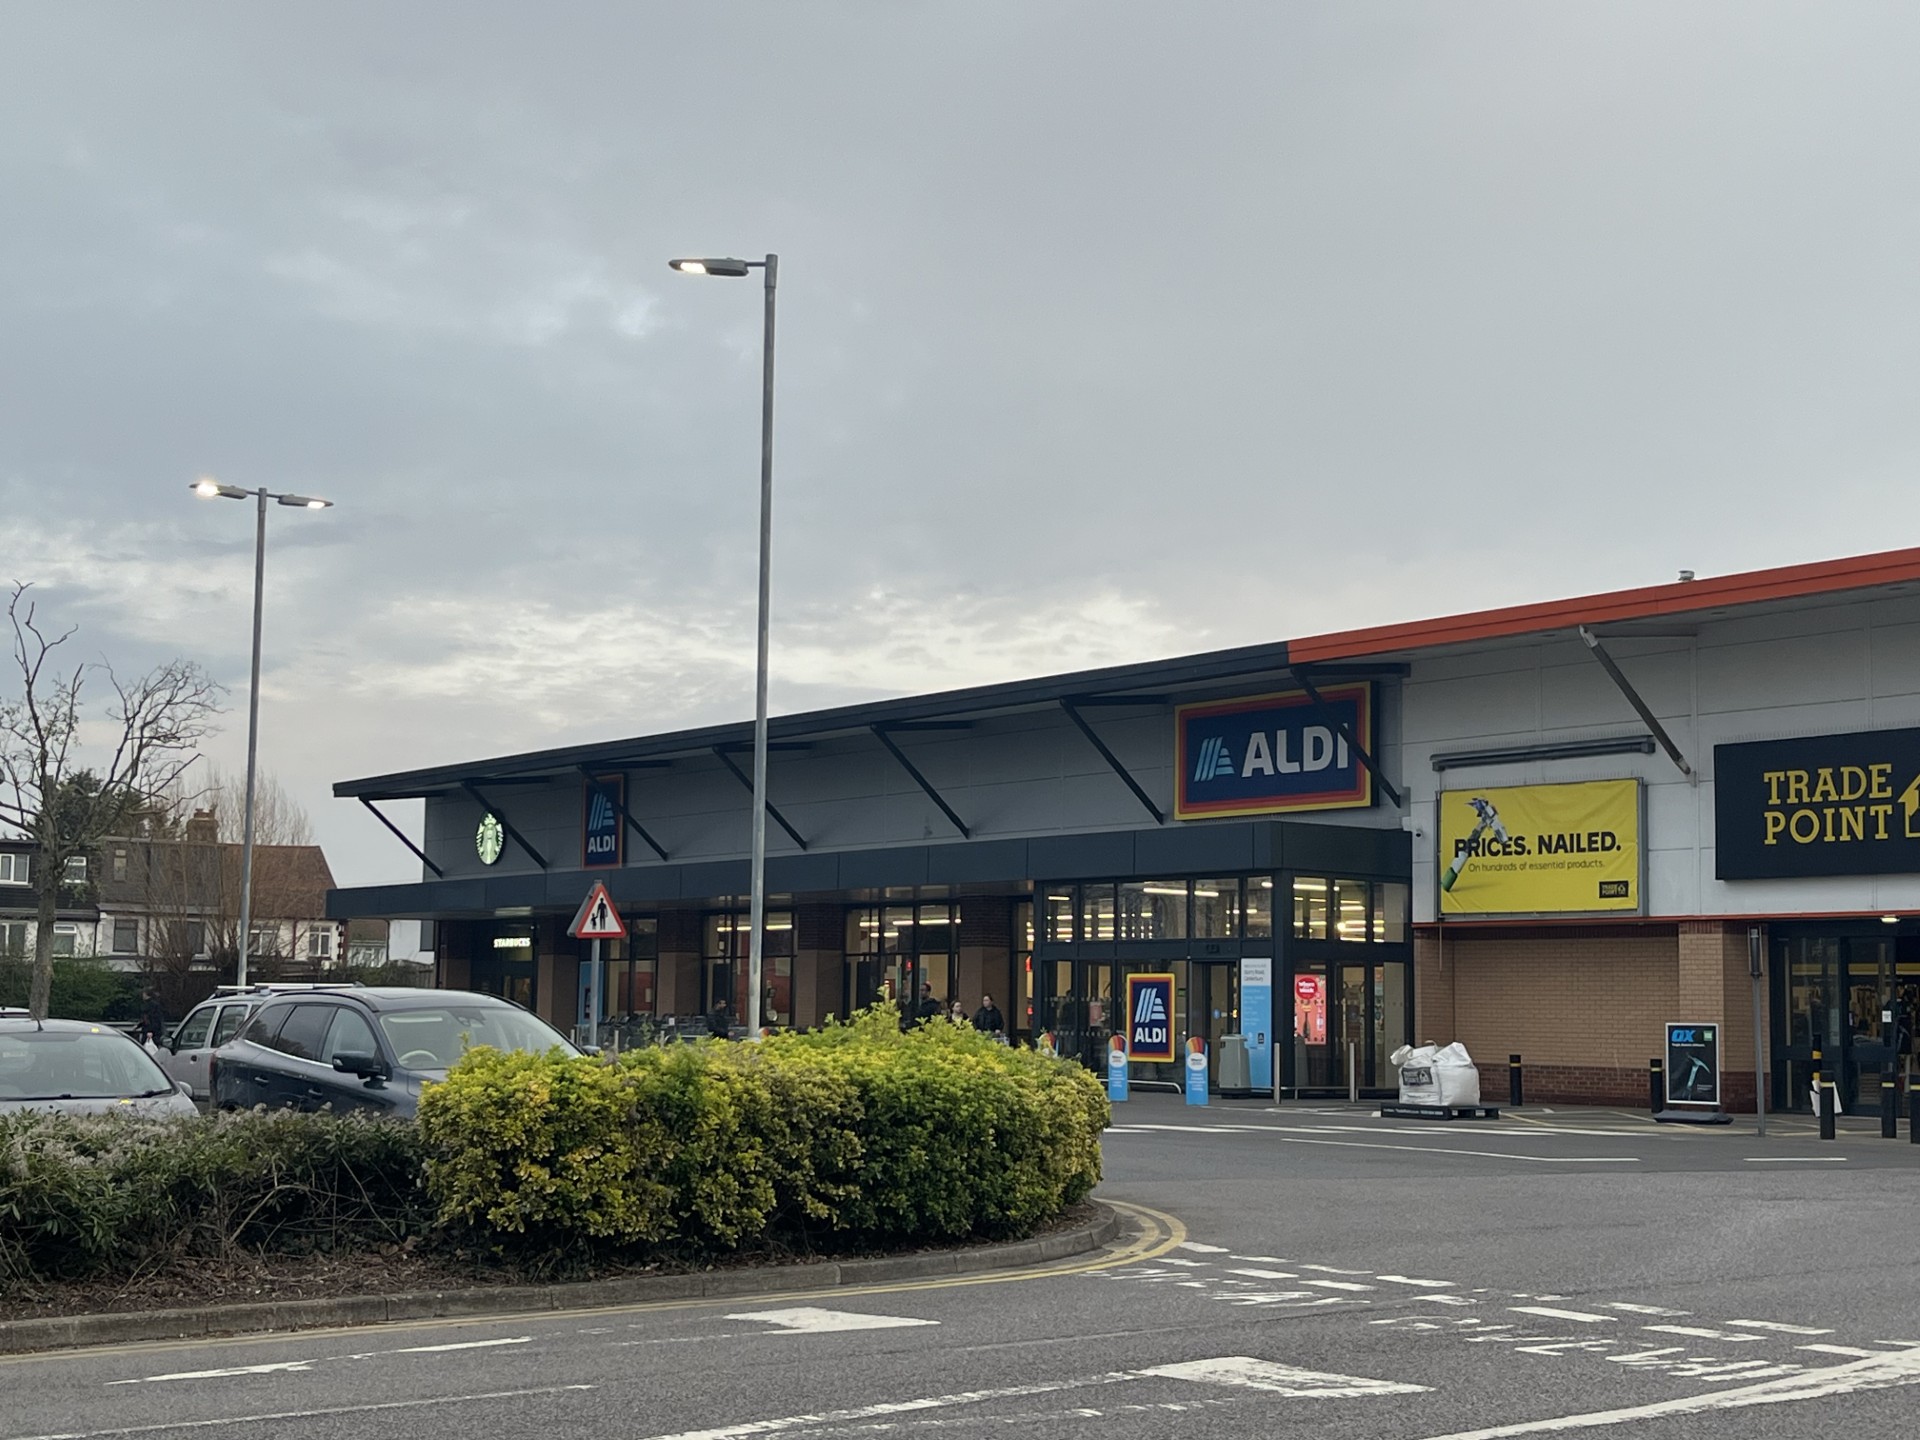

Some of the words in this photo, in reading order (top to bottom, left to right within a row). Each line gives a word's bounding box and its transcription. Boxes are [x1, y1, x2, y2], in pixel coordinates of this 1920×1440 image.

[1241, 722, 1349, 778] ALDI
[1763, 763, 1892, 805] TRADE
[1764, 804, 1893, 845] POINT
[588, 834, 616, 854] ALDI
[1454, 836, 1531, 858] PRICES.
[1537, 831, 1621, 855] NAILED.
[1468, 863, 1481, 873] On
[1482, 862, 1517, 872] hundreds
[1518, 861, 1528, 871] of
[1529, 860, 1565, 870] essential
[1567, 859, 1606, 871] products.
[493, 937, 531, 948] STARBUCKS
[1134, 1027, 1167, 1043] ALDI
[1671, 1029, 1696, 1043] OX
